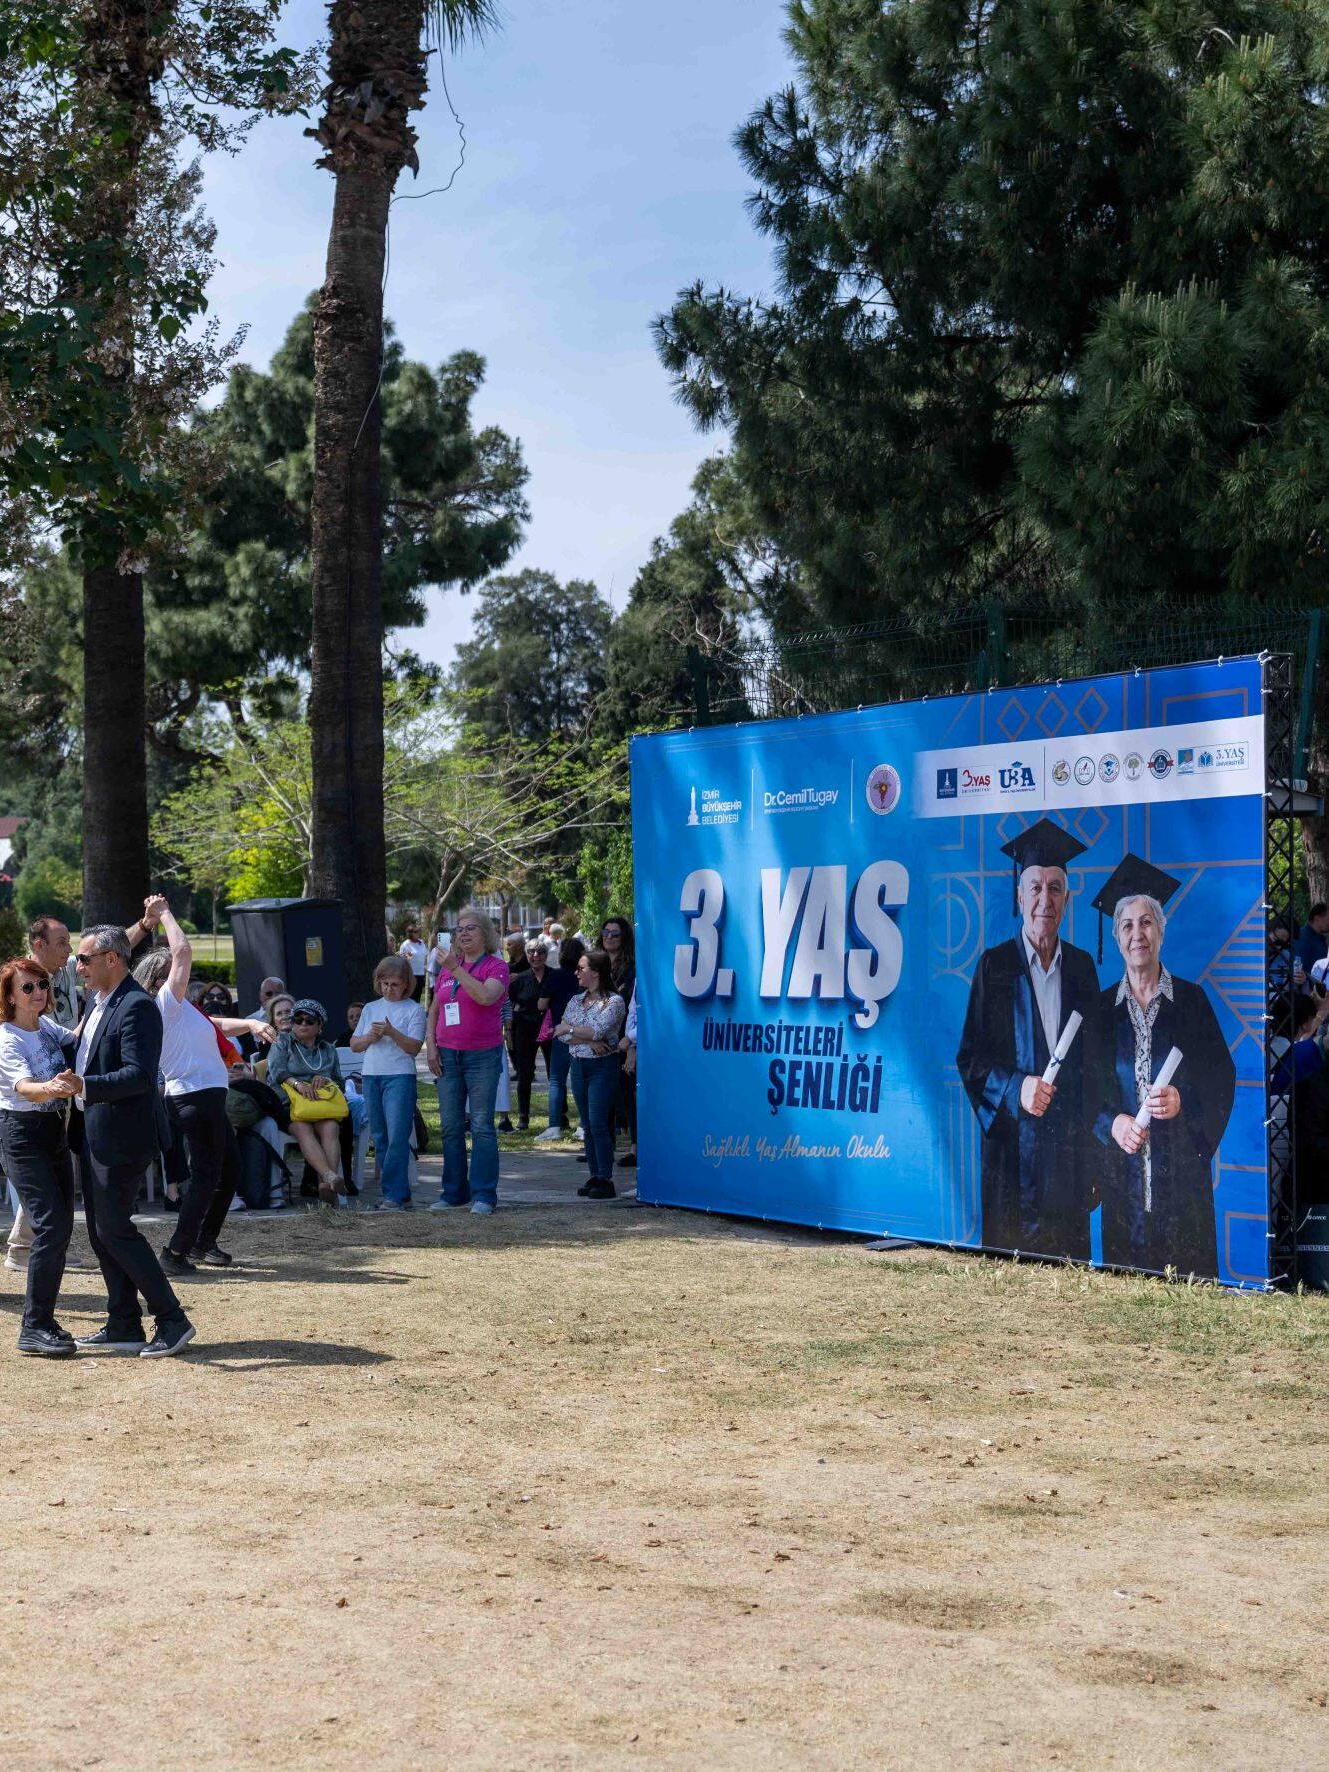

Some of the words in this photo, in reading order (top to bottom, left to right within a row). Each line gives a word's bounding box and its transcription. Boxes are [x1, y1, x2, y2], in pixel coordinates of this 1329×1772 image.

[702, 789, 720, 800] İZMİR
[702, 799, 742, 813] BÜYÜKŞEHİR
[702, 813, 739, 825] BELEDİYESİ
[673, 868, 735, 1001] 3.
[758, 859, 910, 1030] YAŞ
[702, 1017, 844, 1057] ÜNİVERSİTELERİ
[767, 1053, 883, 1115] ŞENLİĞİ
[703, 1134, 751, 1168] Sağlıklı
[755, 1136, 777, 1163] Yaş
[777, 1135, 842, 1160] Almanın
[846, 1134, 892, 1160] Okulu
